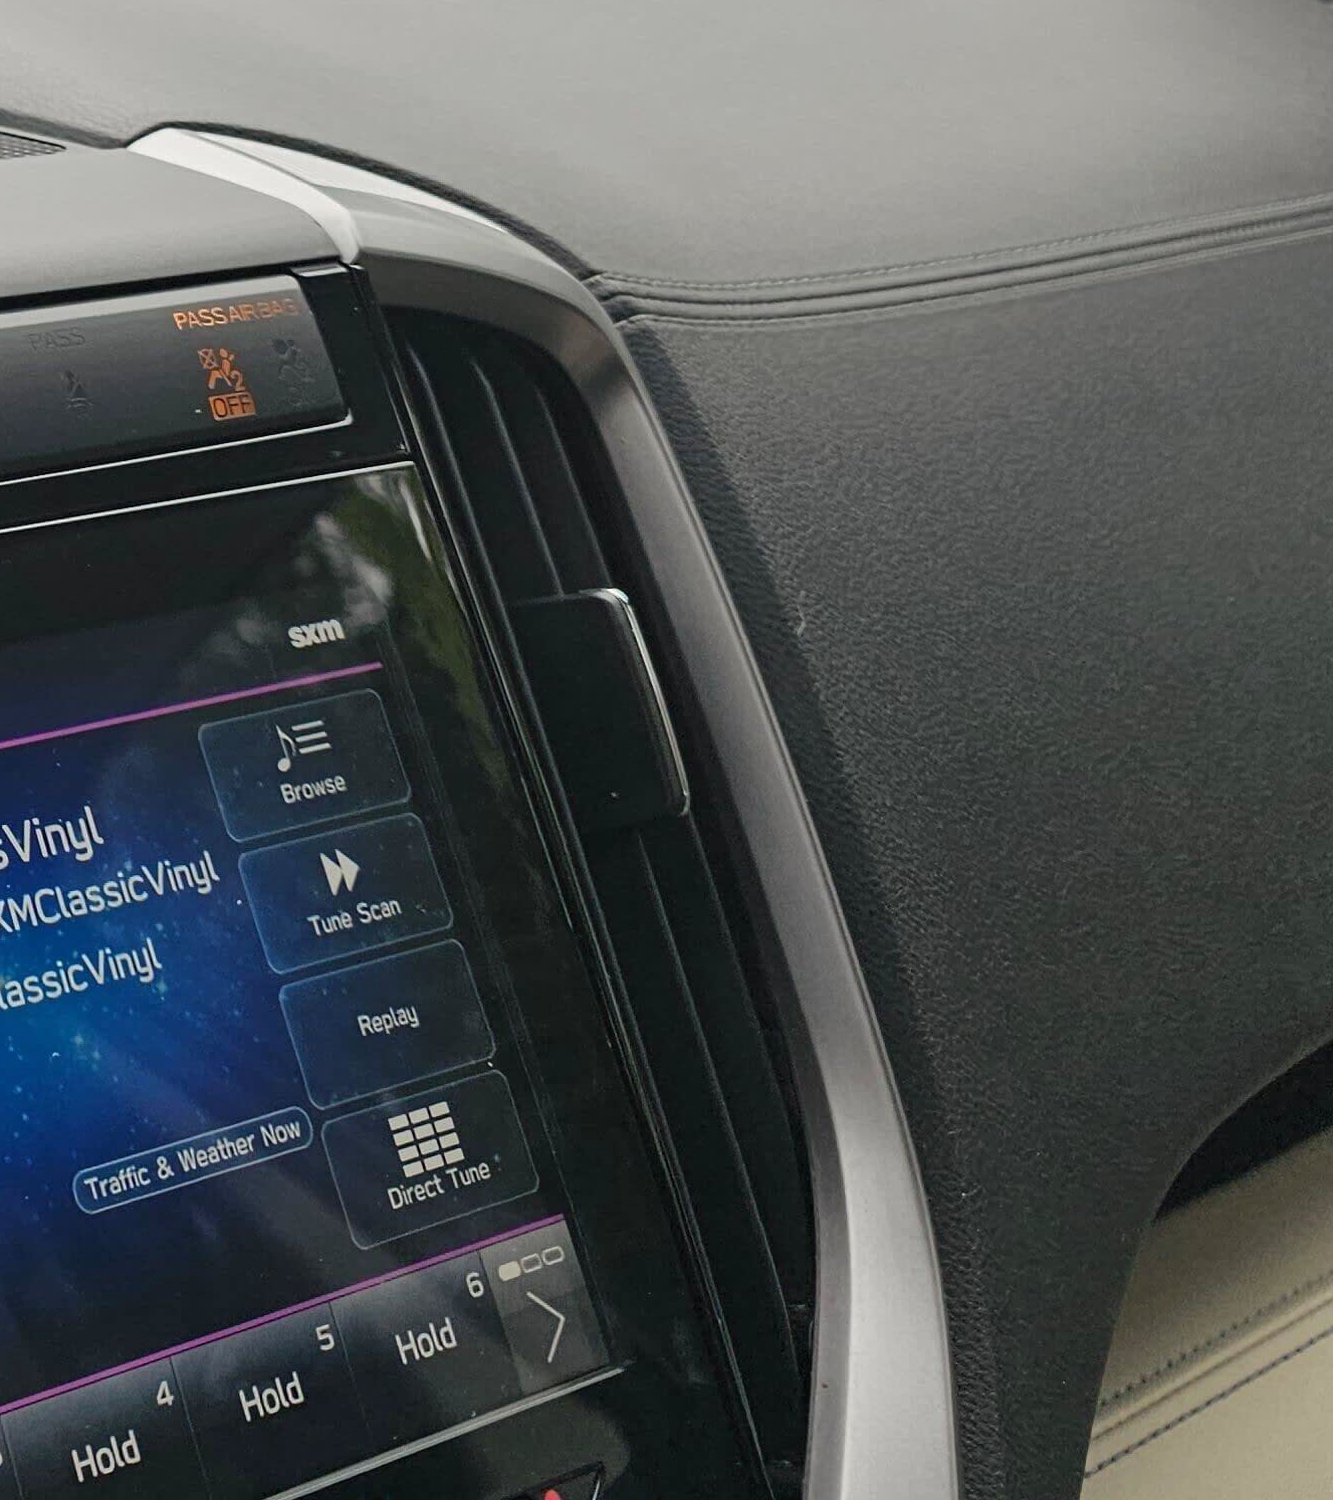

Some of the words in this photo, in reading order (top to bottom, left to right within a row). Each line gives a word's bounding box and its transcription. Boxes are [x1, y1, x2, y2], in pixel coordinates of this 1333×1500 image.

[213, 394, 251, 418] OFF
[288, 617, 345, 648] sxm
[280, 772, 347, 804] Browse
[308, 912, 353, 938] Tune
[358, 896, 402, 928] Scan
[358, 1005, 419, 1038] Replay
[85, 1163, 151, 1204] Traffic
[157, 1156, 174, 1179] &
[178, 1132, 255, 1173] Weather
[260, 1117, 302, 1153] Now
[388, 1176, 444, 1210] Direct
[450, 1160, 491, 1194] Tune
[466, 1273, 484, 1299] 6
[316, 1325, 335, 1351] 5
[397, 1319, 458, 1365] Hold
[156, 1381, 174, 1406] 4
[240, 1372, 304, 1422] Hold
[71, 1429, 141, 1482] Hold
